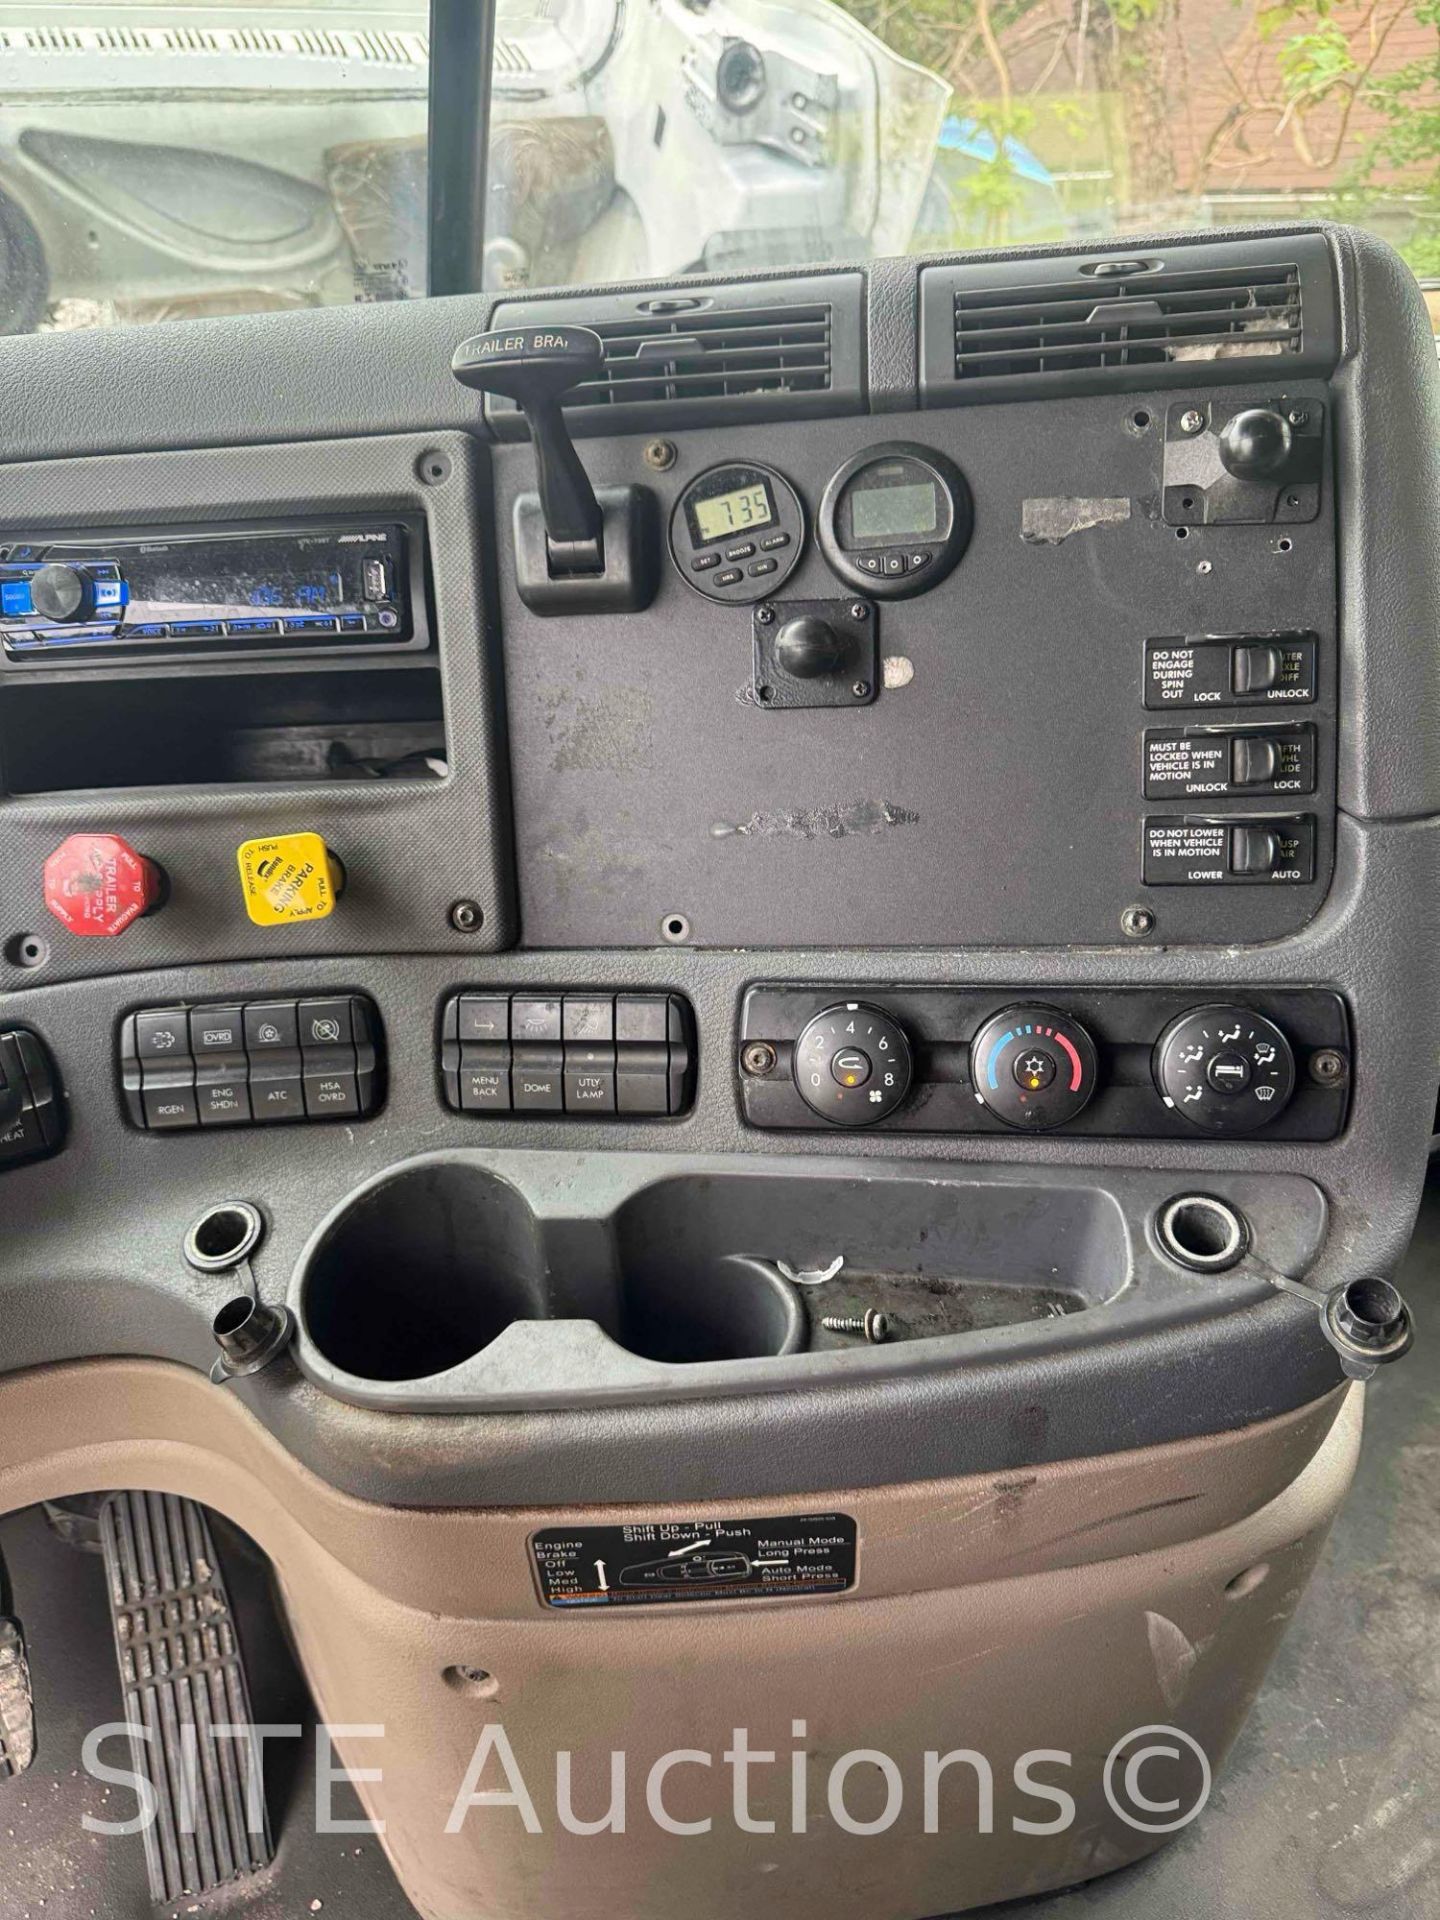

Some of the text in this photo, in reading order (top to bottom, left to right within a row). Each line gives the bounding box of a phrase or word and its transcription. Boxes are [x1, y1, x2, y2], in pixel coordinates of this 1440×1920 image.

[464, 335, 568, 356] TRAILER BRA
[728, 546, 751, 557] SNOOZE
[1153, 650, 1194, 660] DO NOT
[1152, 660, 1194, 670] ENGAGE
[1153, 670, 1193, 680] DURING
[1161, 680, 1184, 689] SPIN
[1162, 689, 1184, 699] OUT
[1194, 692, 1221, 702] LOCK
[1267, 689, 1309, 699] UNLOCK
[1150, 742, 1191, 752] MUST BE
[1150, 751, 1222, 762] LOCKED WHEN
[1150, 760, 1215, 771] VEHICLE IS IN
[1150, 772, 1191, 781] MOTION
[1186, 783, 1228, 793] UNLOCK
[1274, 780, 1301, 789] LOCK
[1150, 828, 1224, 838] DO NOT LOWER
[1150, 838, 1223, 848] WHEN VEHICLE
[1153, 848, 1220, 857] IS IN MOTION
[244, 844, 279, 897] PUSH TO RELEASE
[1188, 870, 1223, 880] LOWER
[1271, 870, 1301, 879] AUTO
[270, 864, 296, 896] BRAKE
[105, 858, 117, 913] TRAILER
[273, 862, 314, 913] PARKING
[289, 877, 328, 917] PULL TO APPLY
[107, 902, 140, 933] EVACUATE
[845, 1020, 855, 1034] 4
[205, 1032, 232, 1042] OVRD
[815, 1035, 825, 1049] 2
[878, 1036, 888, 1050] 6
[471, 1077, 499, 1085] MENU
[578, 1078, 600, 1087] UTLY
[811, 1073, 821, 1086] 0
[884, 1072, 894, 1086] 8
[320, 1082, 341, 1090] HSA
[524, 1084, 551, 1093] DOME
[212, 1088, 233, 1098] ENG
[268, 1091, 288, 1101] ATC
[473, 1087, 498, 1096] BACK
[576, 1090, 604, 1099] LAMP
[318, 1093, 346, 1102] OVRD
[158, 1105, 185, 1115] RGEN
[210, 1100, 239, 1110] SHDN
[623, 1526, 654, 1534] Shift
[659, 1525, 680, 1534] Up
[694, 1521, 721, 1530] Pull
[624, 1533, 655, 1542] Shift
[660, 1532, 700, 1540] Down
[715, 1528, 751, 1537] Push
[535, 1541, 583, 1551] Engine
[757, 1536, 845, 1548] Manual Mode
[536, 1551, 577, 1559] Brake
[757, 1547, 830, 1558] Long Press
[545, 1560, 566, 1568] Off
[761, 1567, 792, 1575] Auto
[549, 1577, 578, 1585] Med
[762, 1572, 839, 1582] Short Press
[551, 1585, 583, 1594] High
